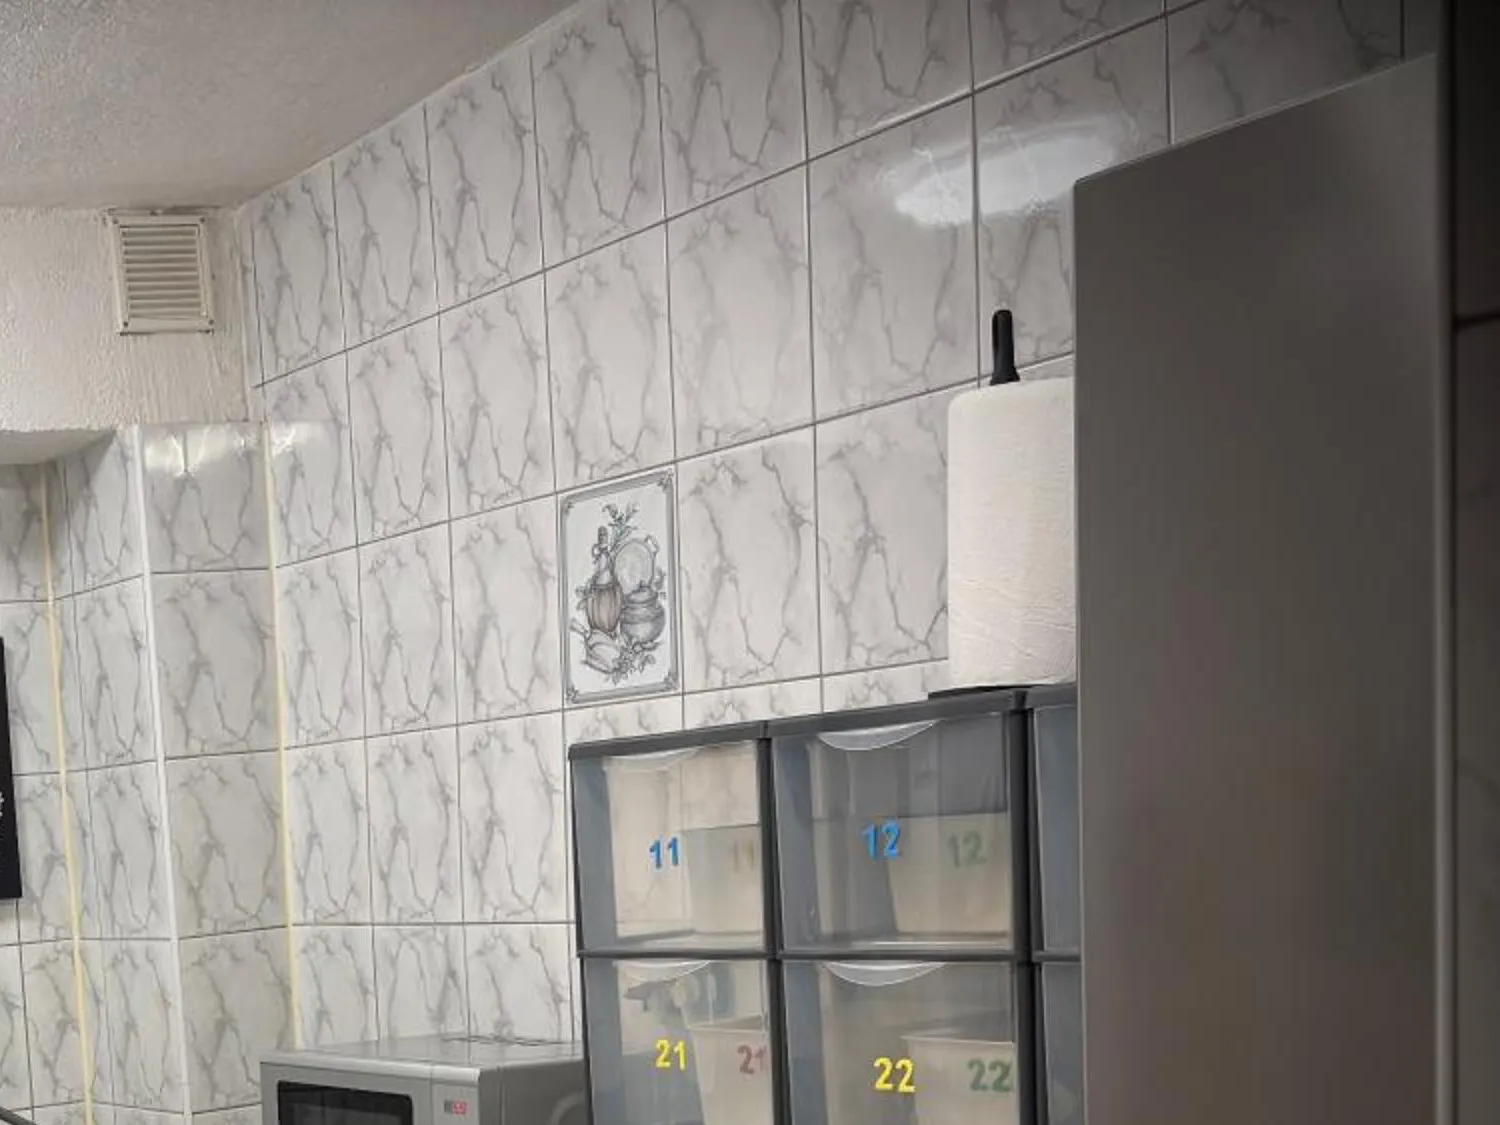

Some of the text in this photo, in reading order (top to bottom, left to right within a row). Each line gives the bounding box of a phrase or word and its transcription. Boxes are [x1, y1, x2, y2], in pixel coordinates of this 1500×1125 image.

[648, 835, 680, 870] 11
[861, 819, 901, 861] 12
[946, 829, 988, 868] 12
[655, 1039, 687, 1071] 21
[873, 1057, 916, 1094] 22
[966, 1058, 1013, 1094] 22
